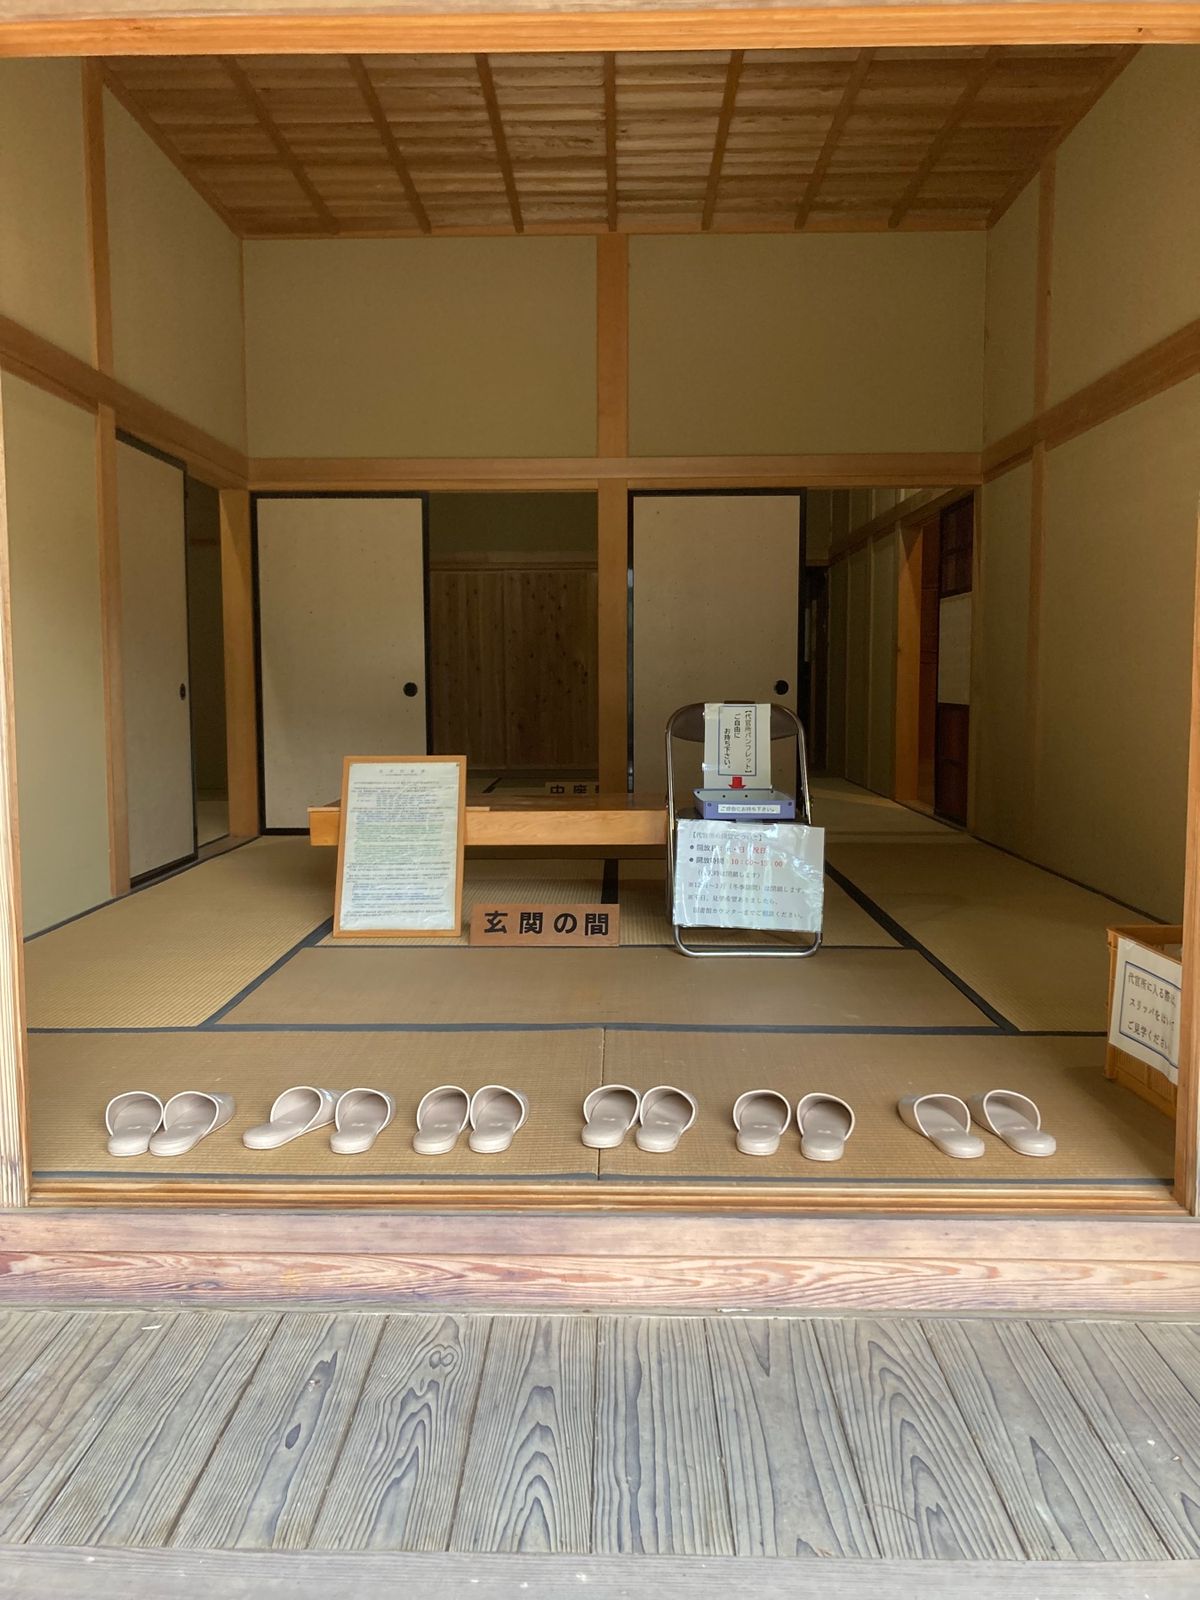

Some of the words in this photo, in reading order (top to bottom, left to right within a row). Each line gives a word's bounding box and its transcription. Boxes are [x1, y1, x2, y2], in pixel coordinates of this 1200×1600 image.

[550, 784, 600, 795] 中座
[484, 910, 609, 936] 玄関の間
